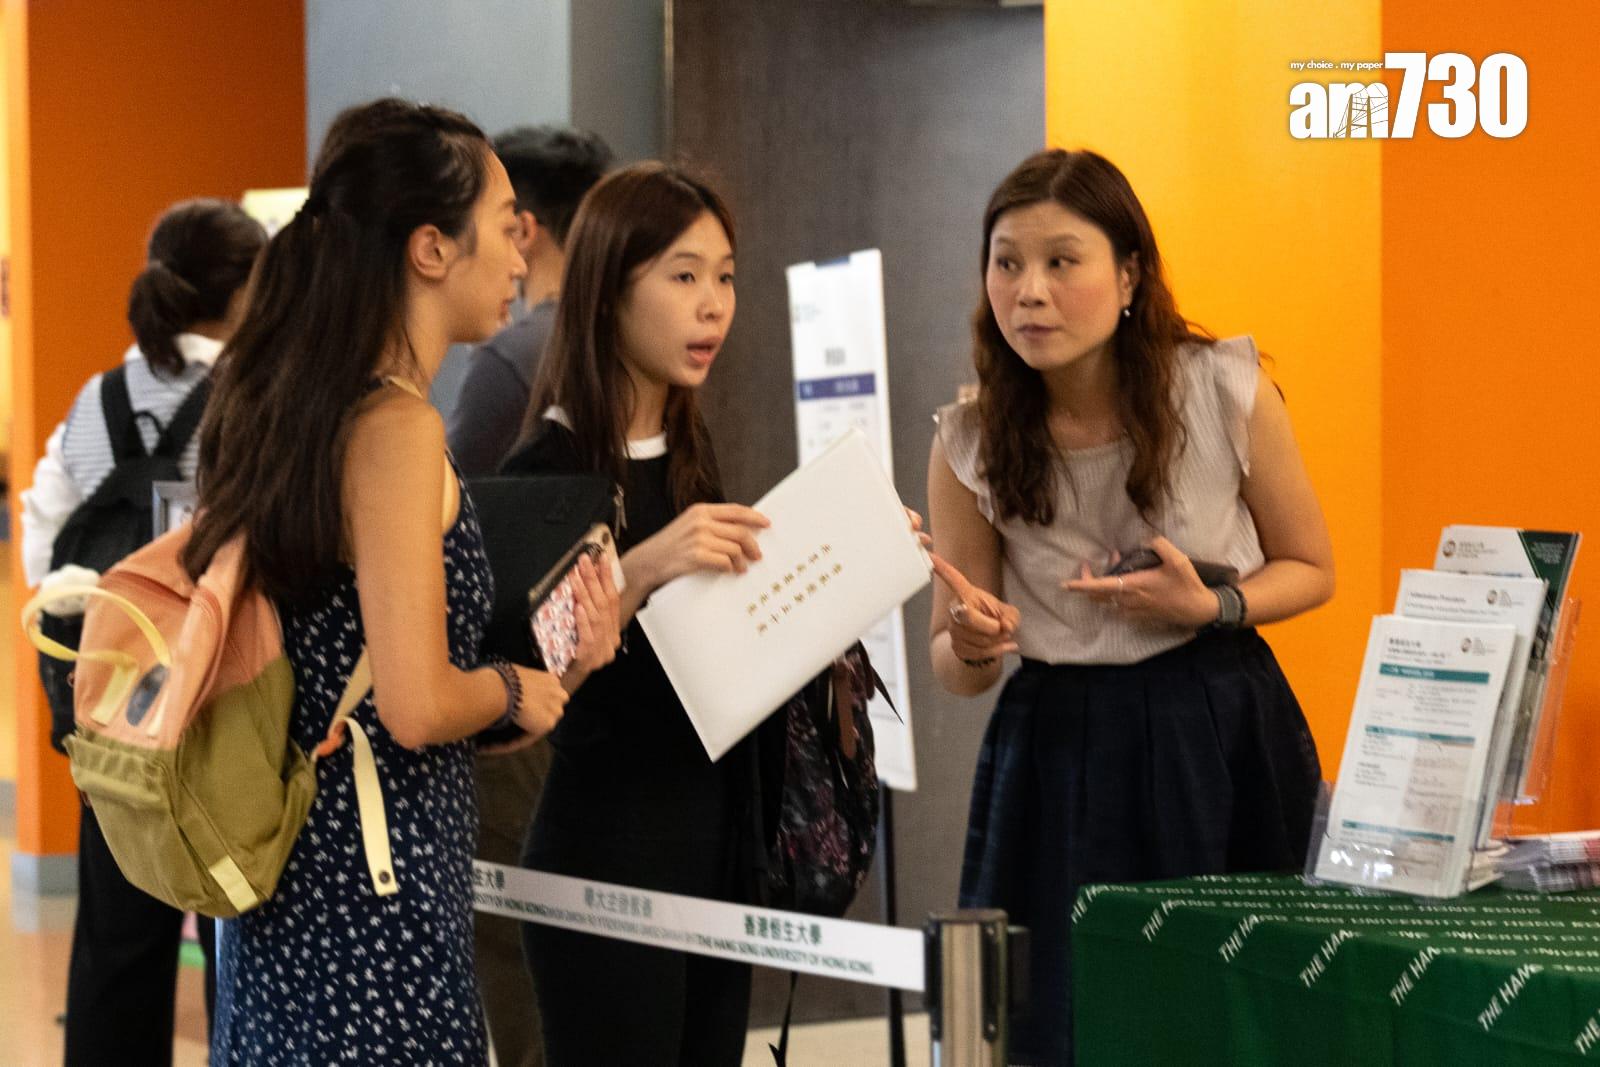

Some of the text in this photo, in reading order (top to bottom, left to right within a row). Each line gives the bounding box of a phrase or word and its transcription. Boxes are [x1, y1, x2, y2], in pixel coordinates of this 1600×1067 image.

[1299, 952, 1327, 988] THE
[1390, 970, 1415, 1007] THE
[1477, 994, 1504, 1033] THE
